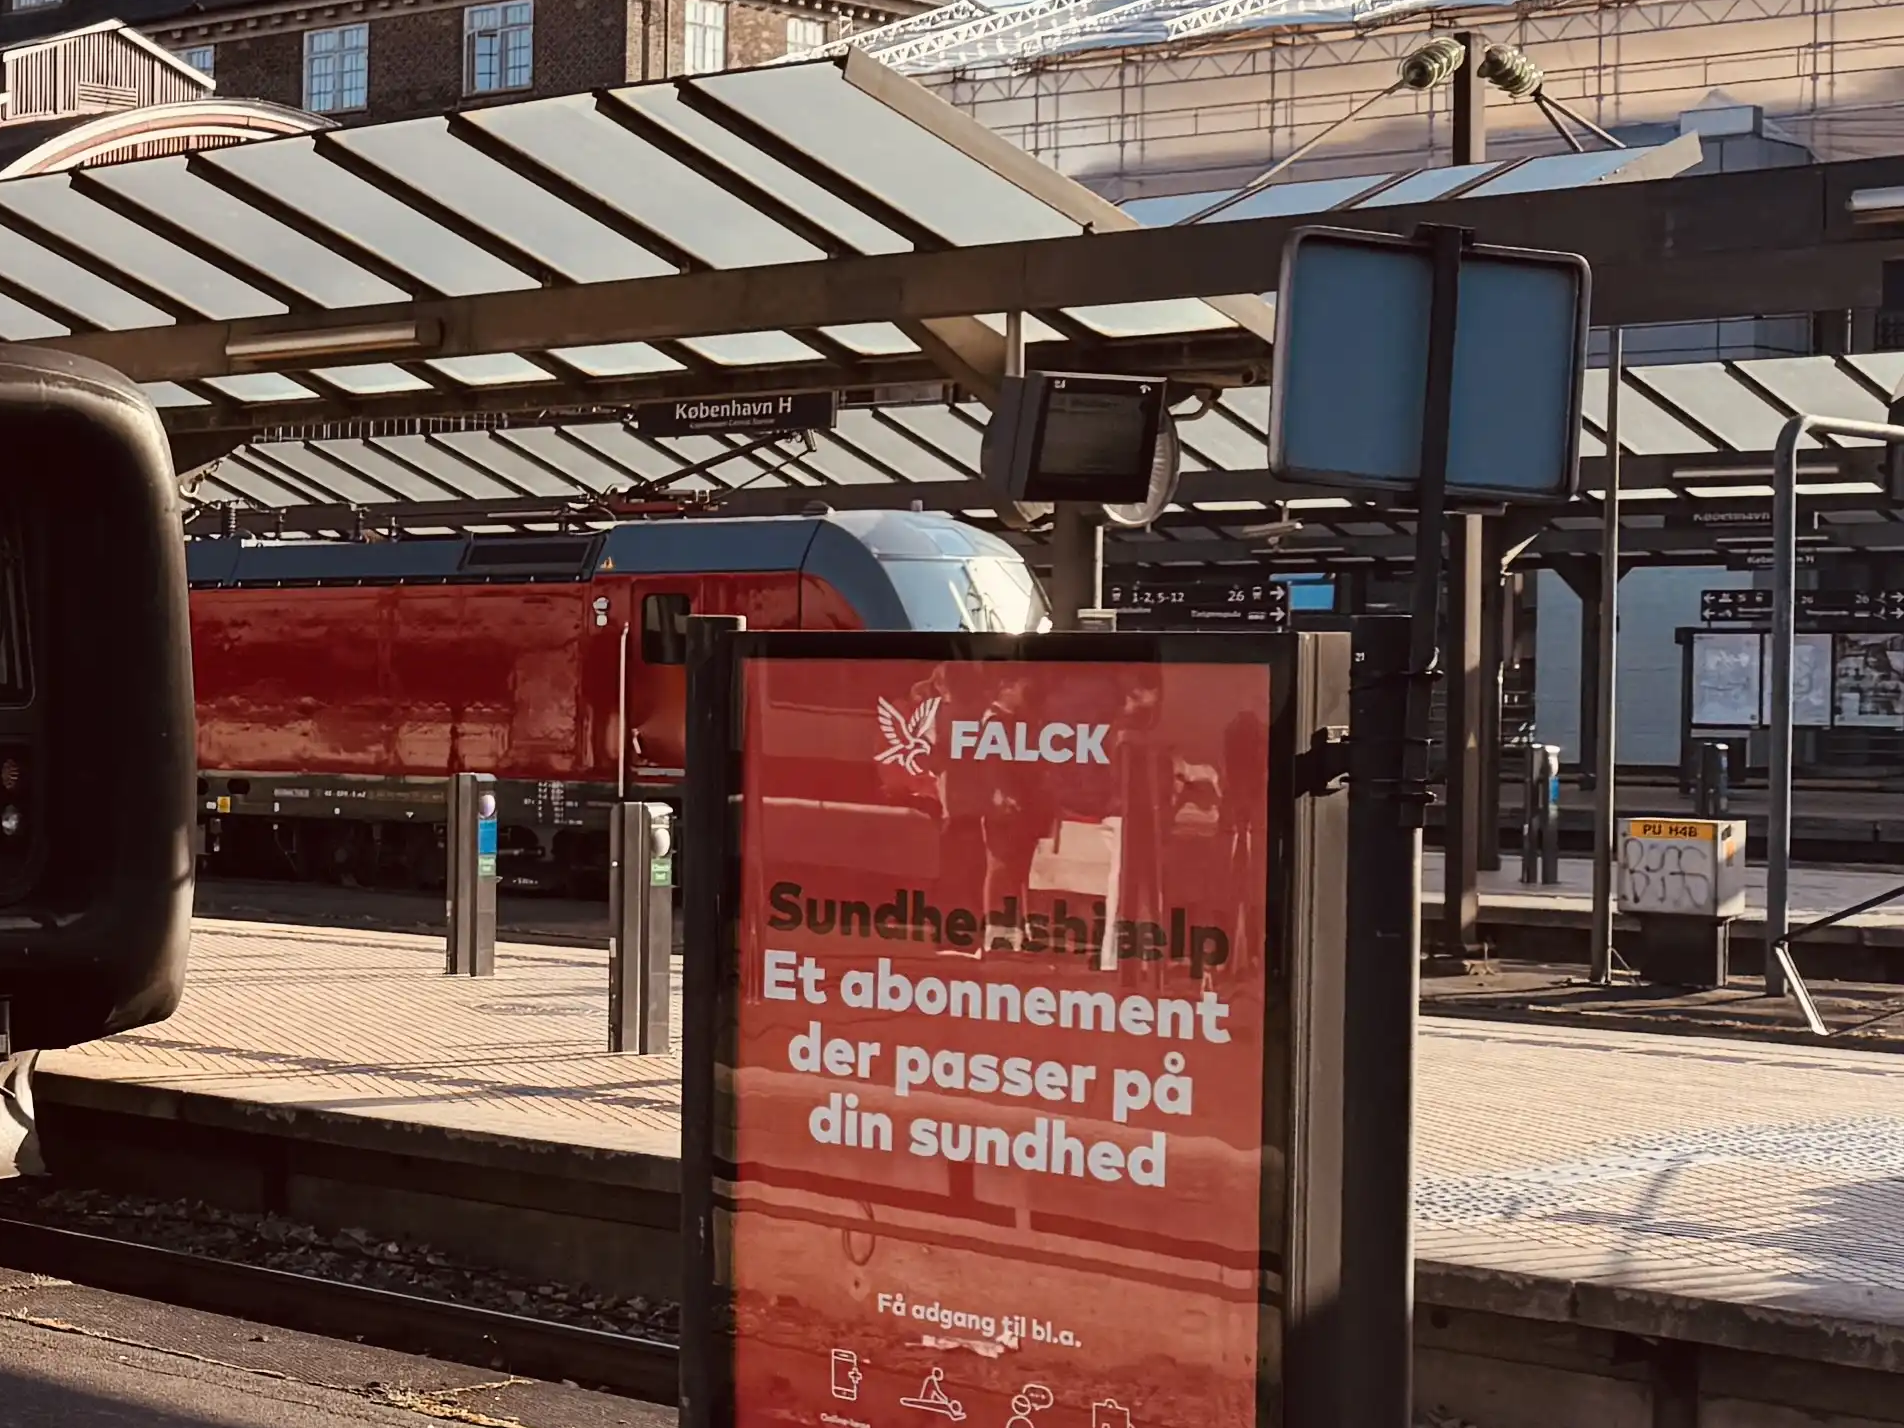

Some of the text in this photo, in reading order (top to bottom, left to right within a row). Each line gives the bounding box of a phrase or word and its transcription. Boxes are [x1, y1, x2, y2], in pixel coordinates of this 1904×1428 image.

[675, 395, 793, 420] København H
[1228, 590, 1245, 603] 26
[950, 720, 1111, 765] FALCK
[1643, 824, 1662, 836] PU
[763, 949, 1231, 1043] Et abonnement
[788, 1021, 1193, 1122] der passer på
[808, 1092, 1167, 1188] din sundhed
[877, 1292, 1082, 1348] Få adgang til bl.a.
